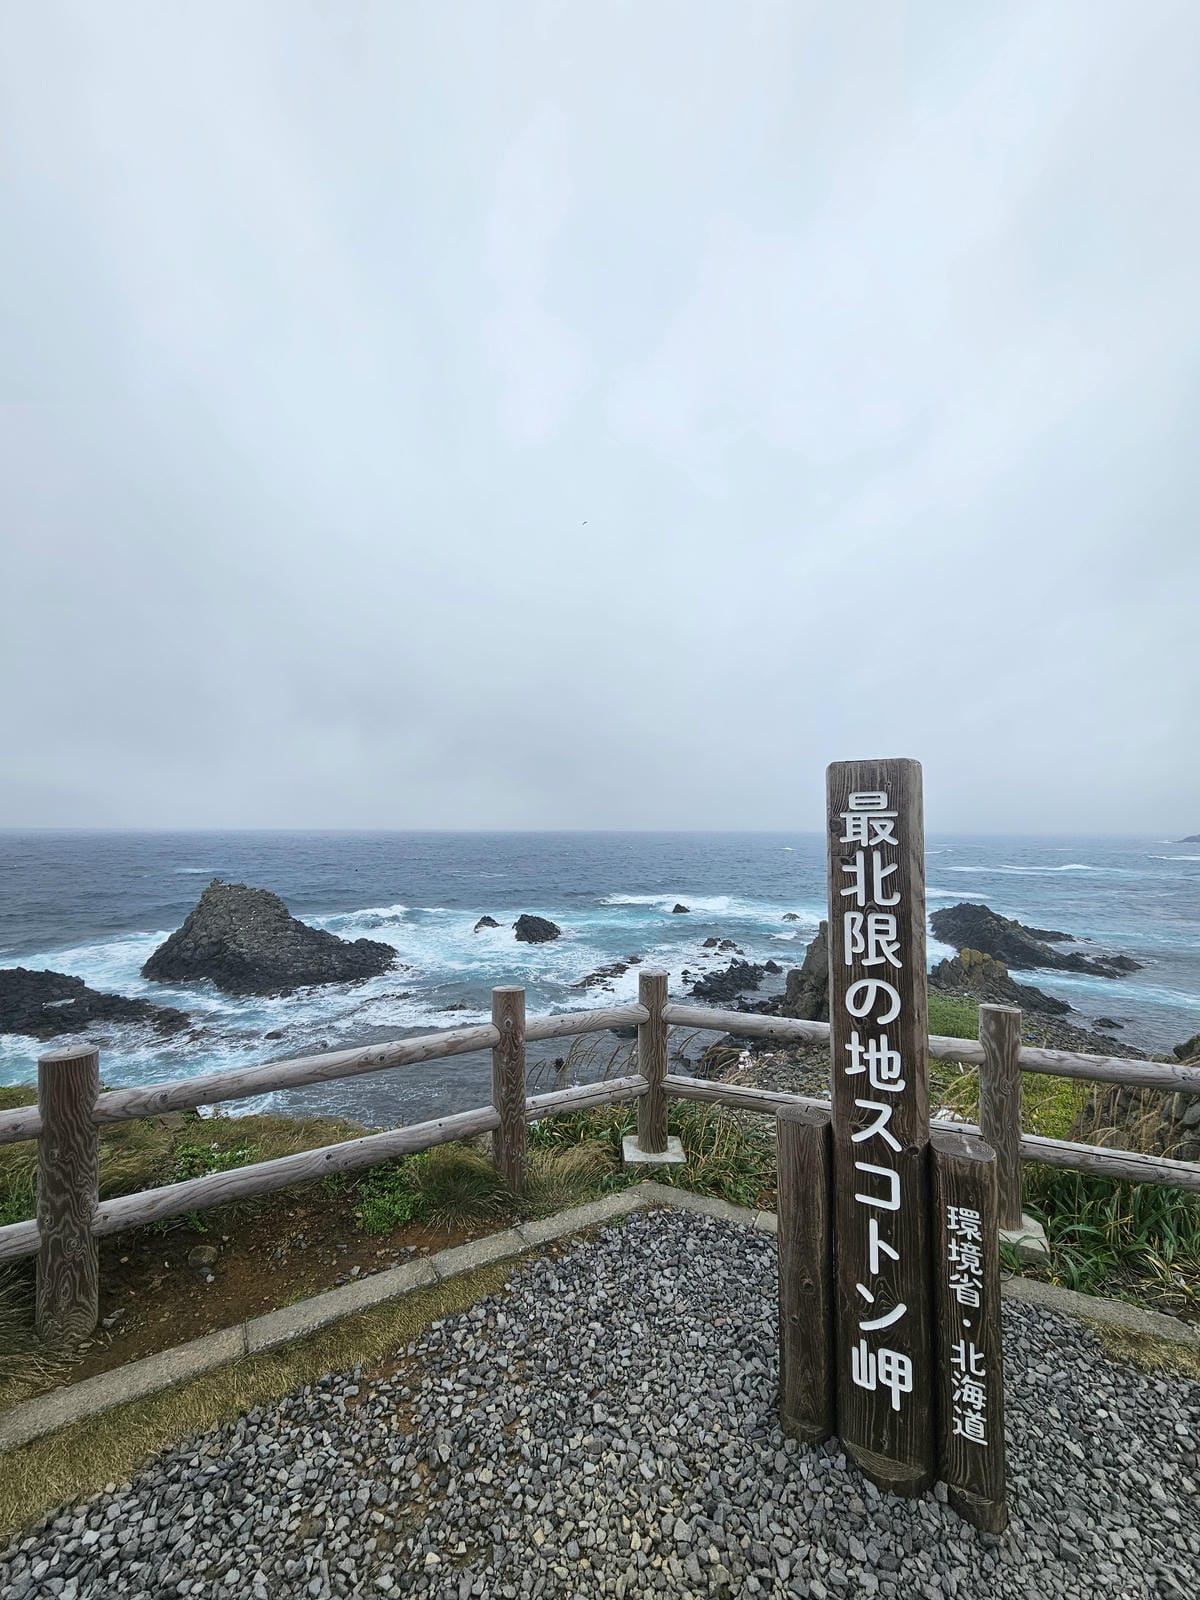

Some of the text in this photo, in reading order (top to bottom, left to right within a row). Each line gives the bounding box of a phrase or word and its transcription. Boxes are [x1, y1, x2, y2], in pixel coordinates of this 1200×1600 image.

[839, 791, 913, 1412] 最北限の地スコトン岬
[946, 1205, 989, 1446] 環境省・北海道
